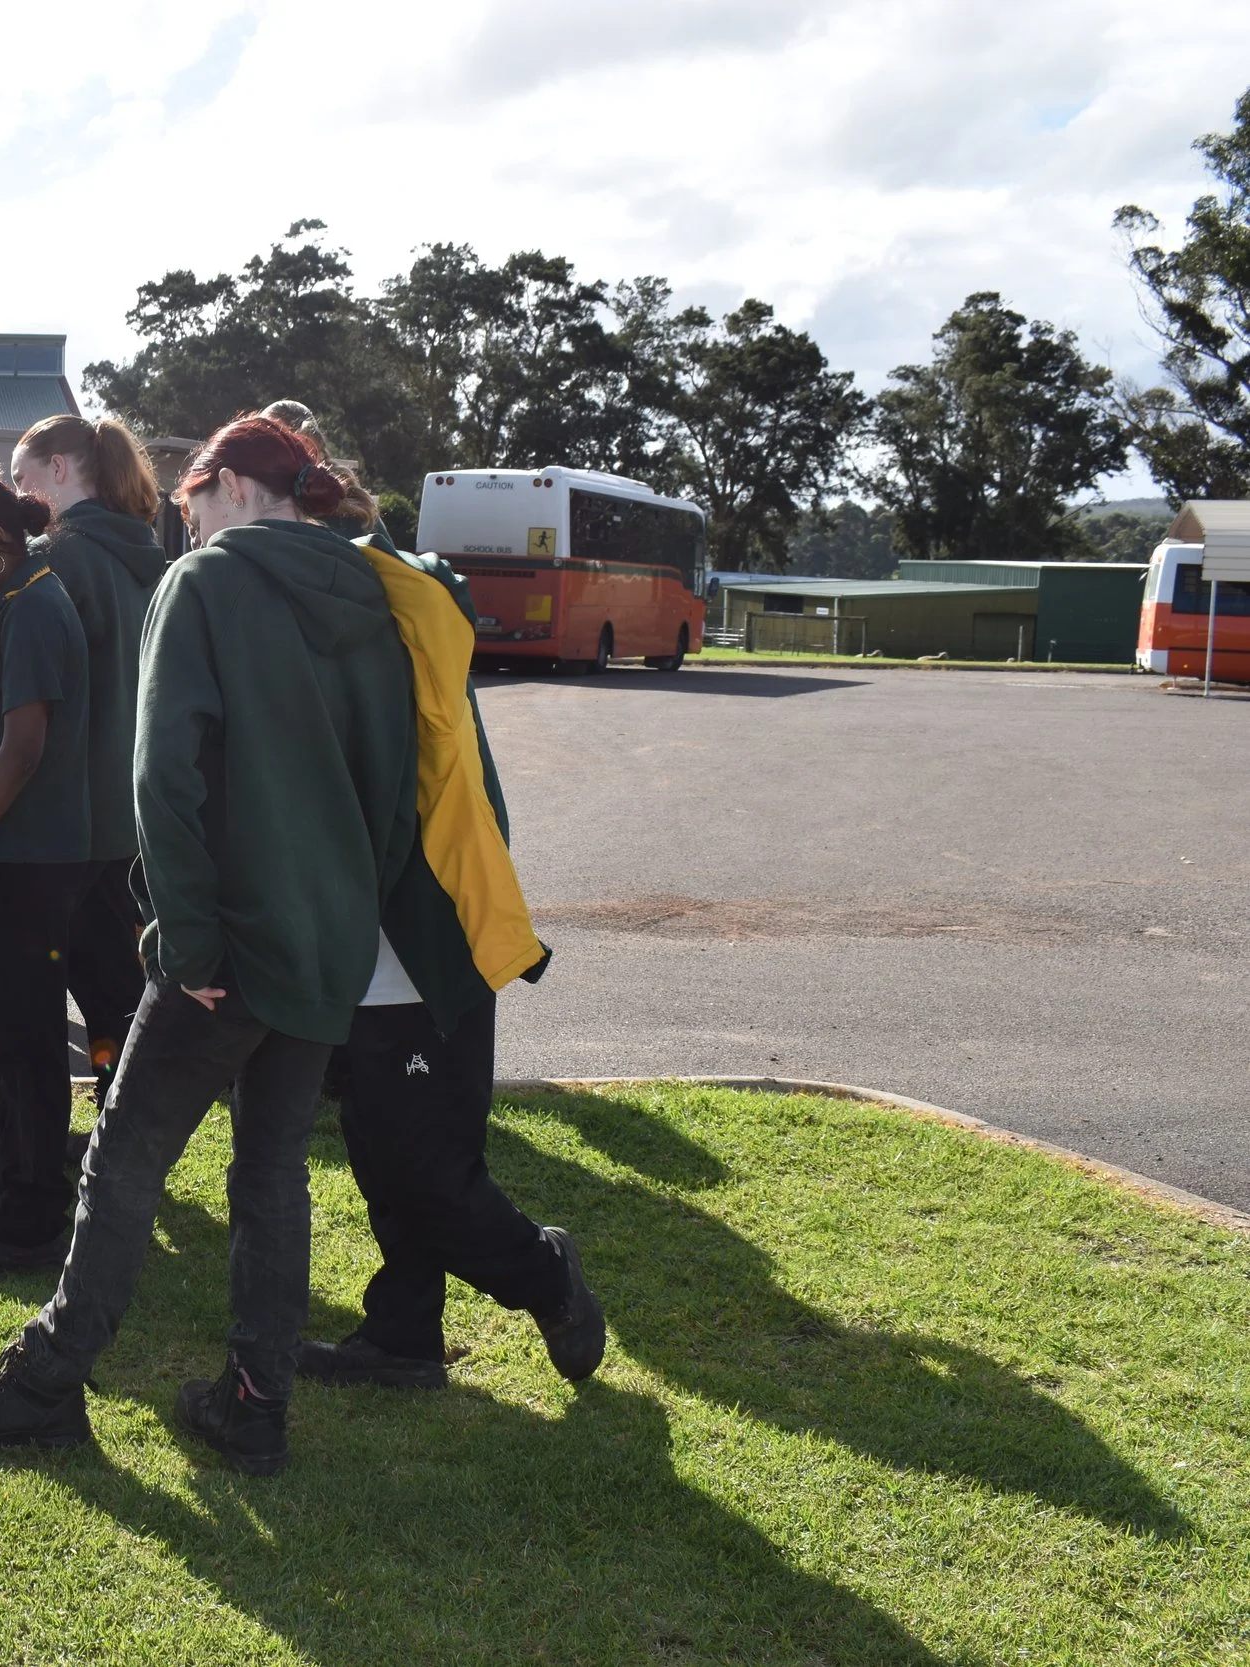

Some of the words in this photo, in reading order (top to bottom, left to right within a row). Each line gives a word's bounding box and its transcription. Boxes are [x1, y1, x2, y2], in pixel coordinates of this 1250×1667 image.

[475, 481, 514, 490] CAUTION
[463, 544, 494, 553] SCHOOL
[496, 546, 512, 554] BUS
